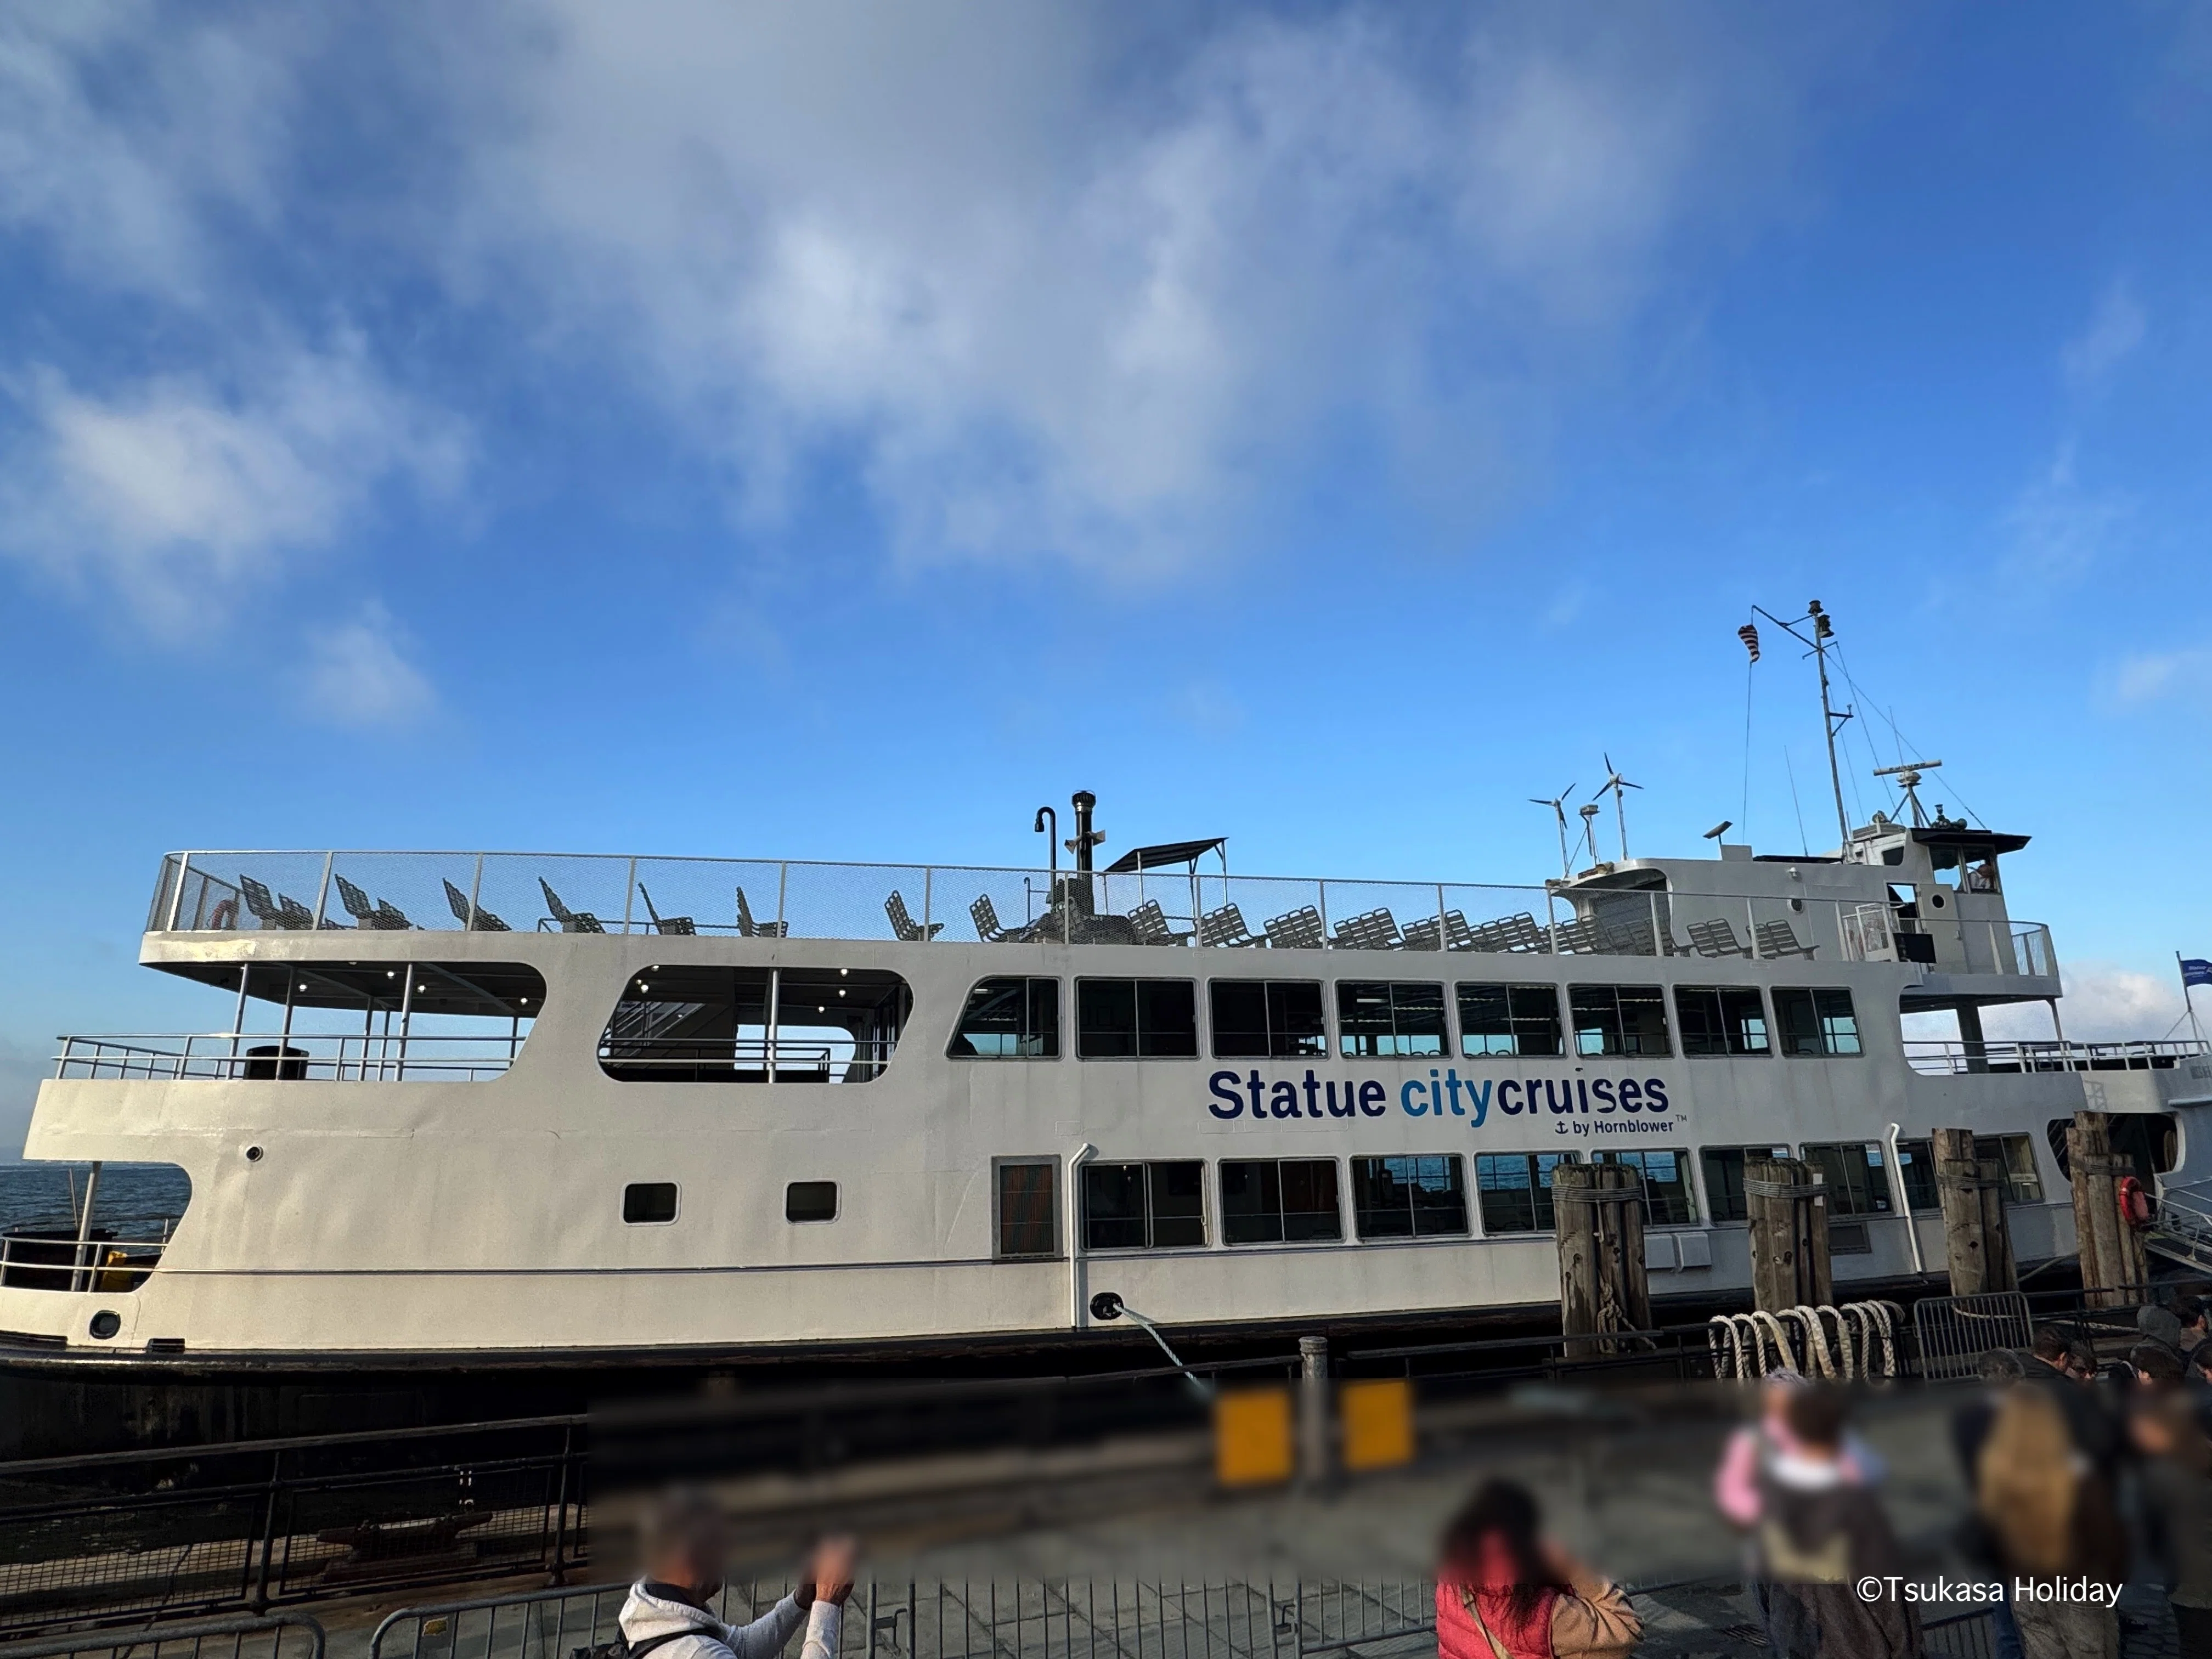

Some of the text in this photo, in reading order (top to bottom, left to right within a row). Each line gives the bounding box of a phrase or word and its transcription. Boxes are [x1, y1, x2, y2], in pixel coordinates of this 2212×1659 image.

[1208, 1069, 1386, 1119] Statue
[1572, 1120, 1590, 1138] by
[1593, 1119, 1674, 1135] Hornblower
